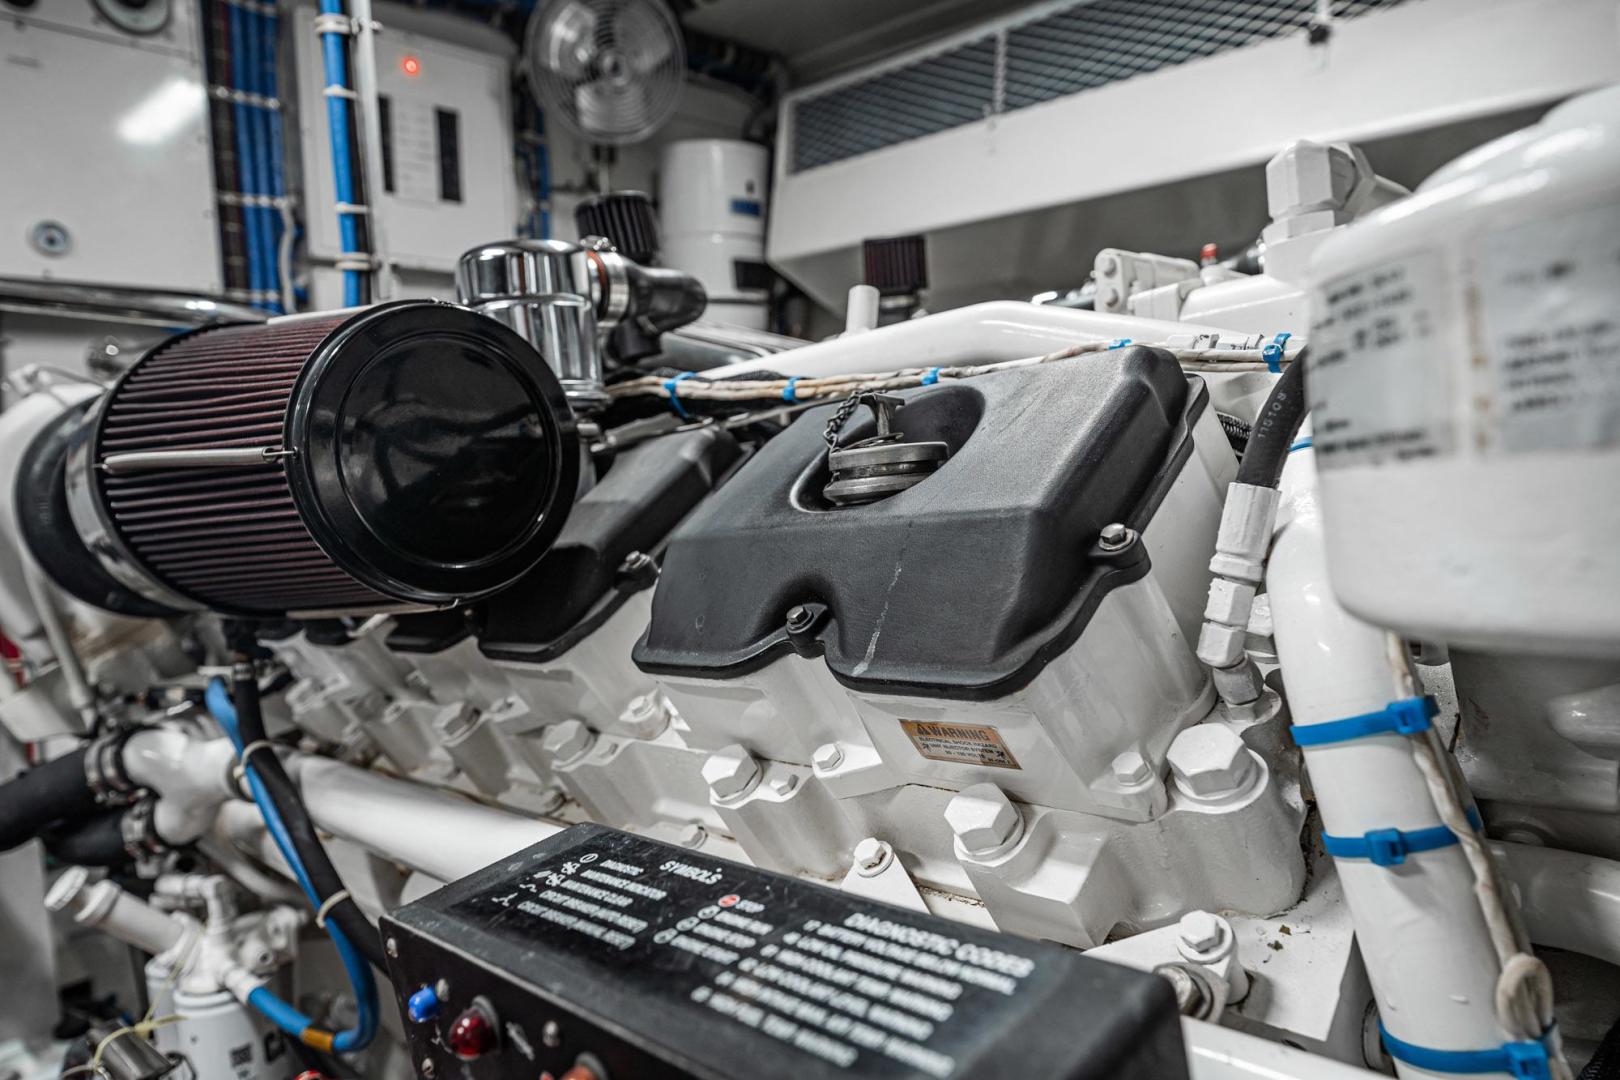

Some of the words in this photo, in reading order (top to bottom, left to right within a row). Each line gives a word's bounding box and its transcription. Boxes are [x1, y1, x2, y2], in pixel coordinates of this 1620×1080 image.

[928, 726, 990, 741] WARNING
[659, 860, 722, 885] SYMBOLS
[844, 912, 959, 956] DIAGNOSTIC
[955, 943, 1035, 978] CODES
